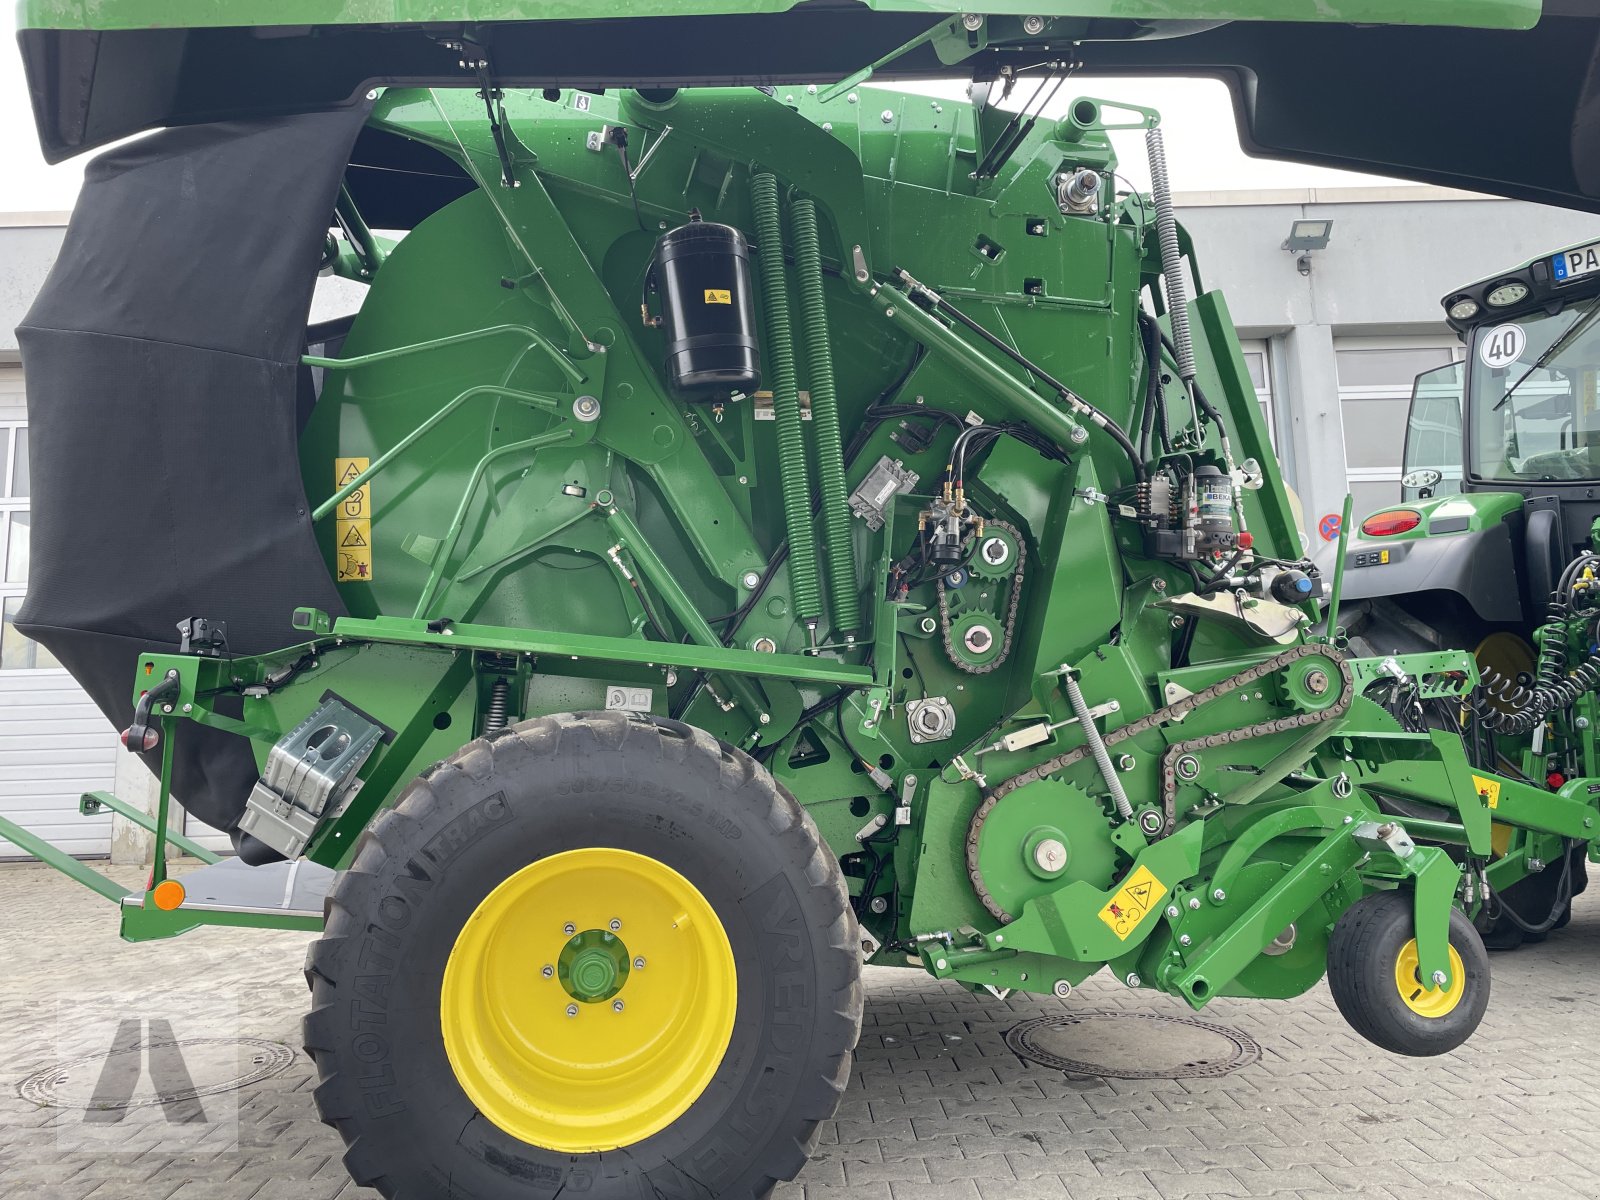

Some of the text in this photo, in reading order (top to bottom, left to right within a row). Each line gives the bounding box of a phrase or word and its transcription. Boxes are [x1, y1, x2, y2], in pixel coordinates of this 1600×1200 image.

[1569, 249, 1599, 273] PA
[1489, 331, 1516, 360] 40
[352, 798, 505, 1119] FLOTATION TRAC
